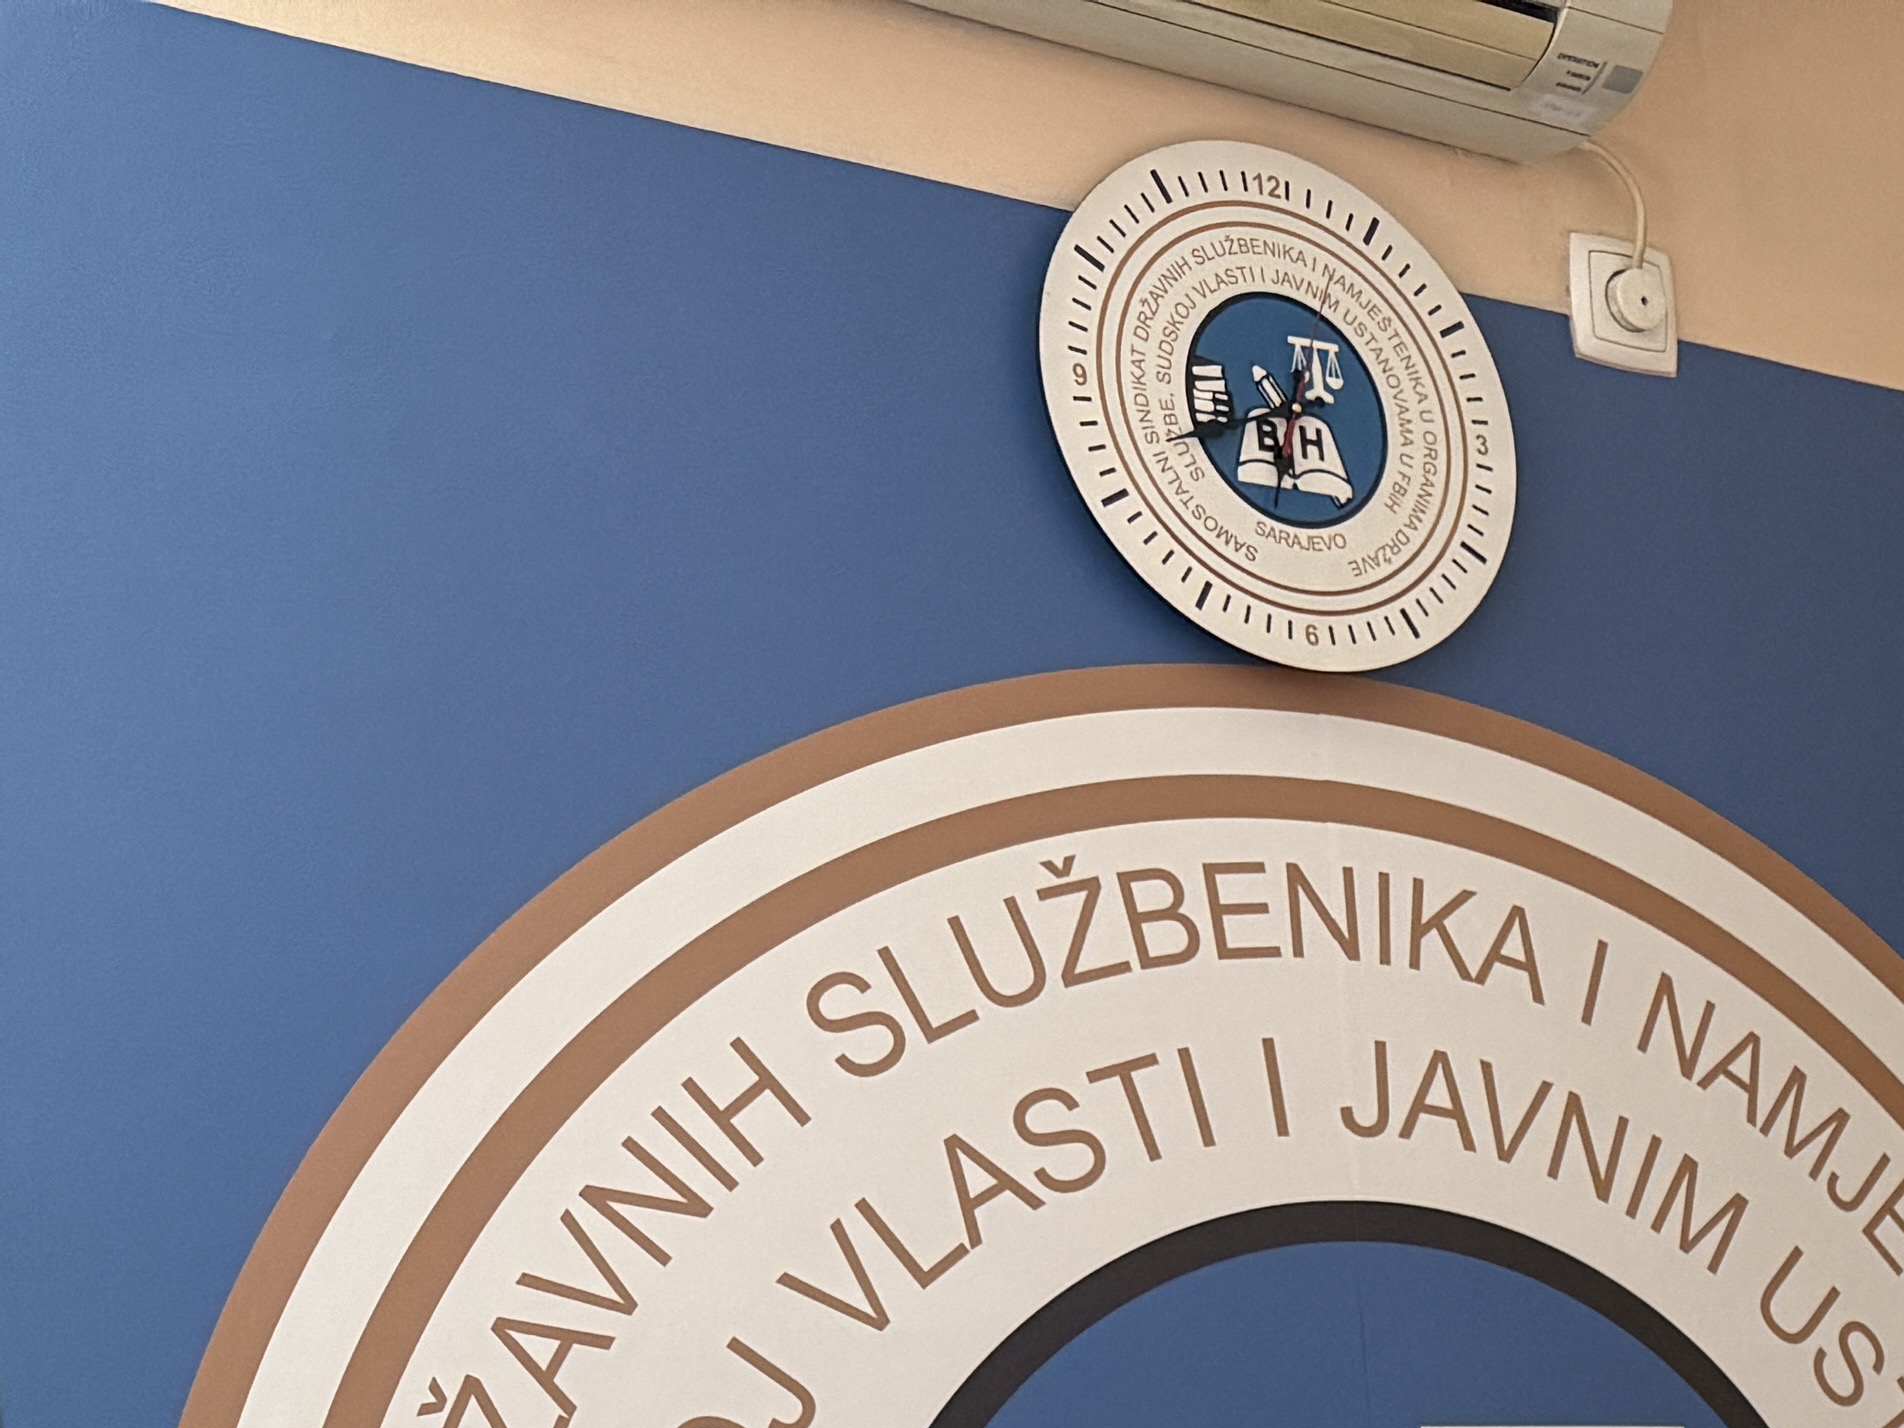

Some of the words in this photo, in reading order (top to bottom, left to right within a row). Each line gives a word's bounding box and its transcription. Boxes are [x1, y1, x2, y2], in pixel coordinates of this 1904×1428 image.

[1252, 174, 1281, 199] 12
[1133, 256, 1193, 343] DRŽAVNIH
[1191, 234, 1307, 268] SLUŽBENIKA
[1322, 263, 1428, 405] NAMJEŠTENIKA
[1130, 344, 1160, 444] SINDIKAT
[1156, 294, 1197, 385] SUDSKOJ
[1192, 266, 1256, 299] VLASTI
[1271, 269, 1341, 313] JAVNIM
[1343, 309, 1415, 447] USTANOVAMA
[1384, 471, 1411, 515] FBIH
[1152, 451, 1259, 562] SAMOSTALNI
[1404, 430, 1438, 531] ORGANIMA
[1255, 520, 1347, 552] SARAJEVO
[1348, 529, 1411, 577] DRŽAVE
[806, 851, 1547, 1080] SLUŽBENIKA
[1581, 936, 1611, 1012] I
[785, 1043, 1220, 1336] VLASTI
[1264, 1034, 1289, 1141] I
[1342, 1042, 1753, 1276] JAVNIM
